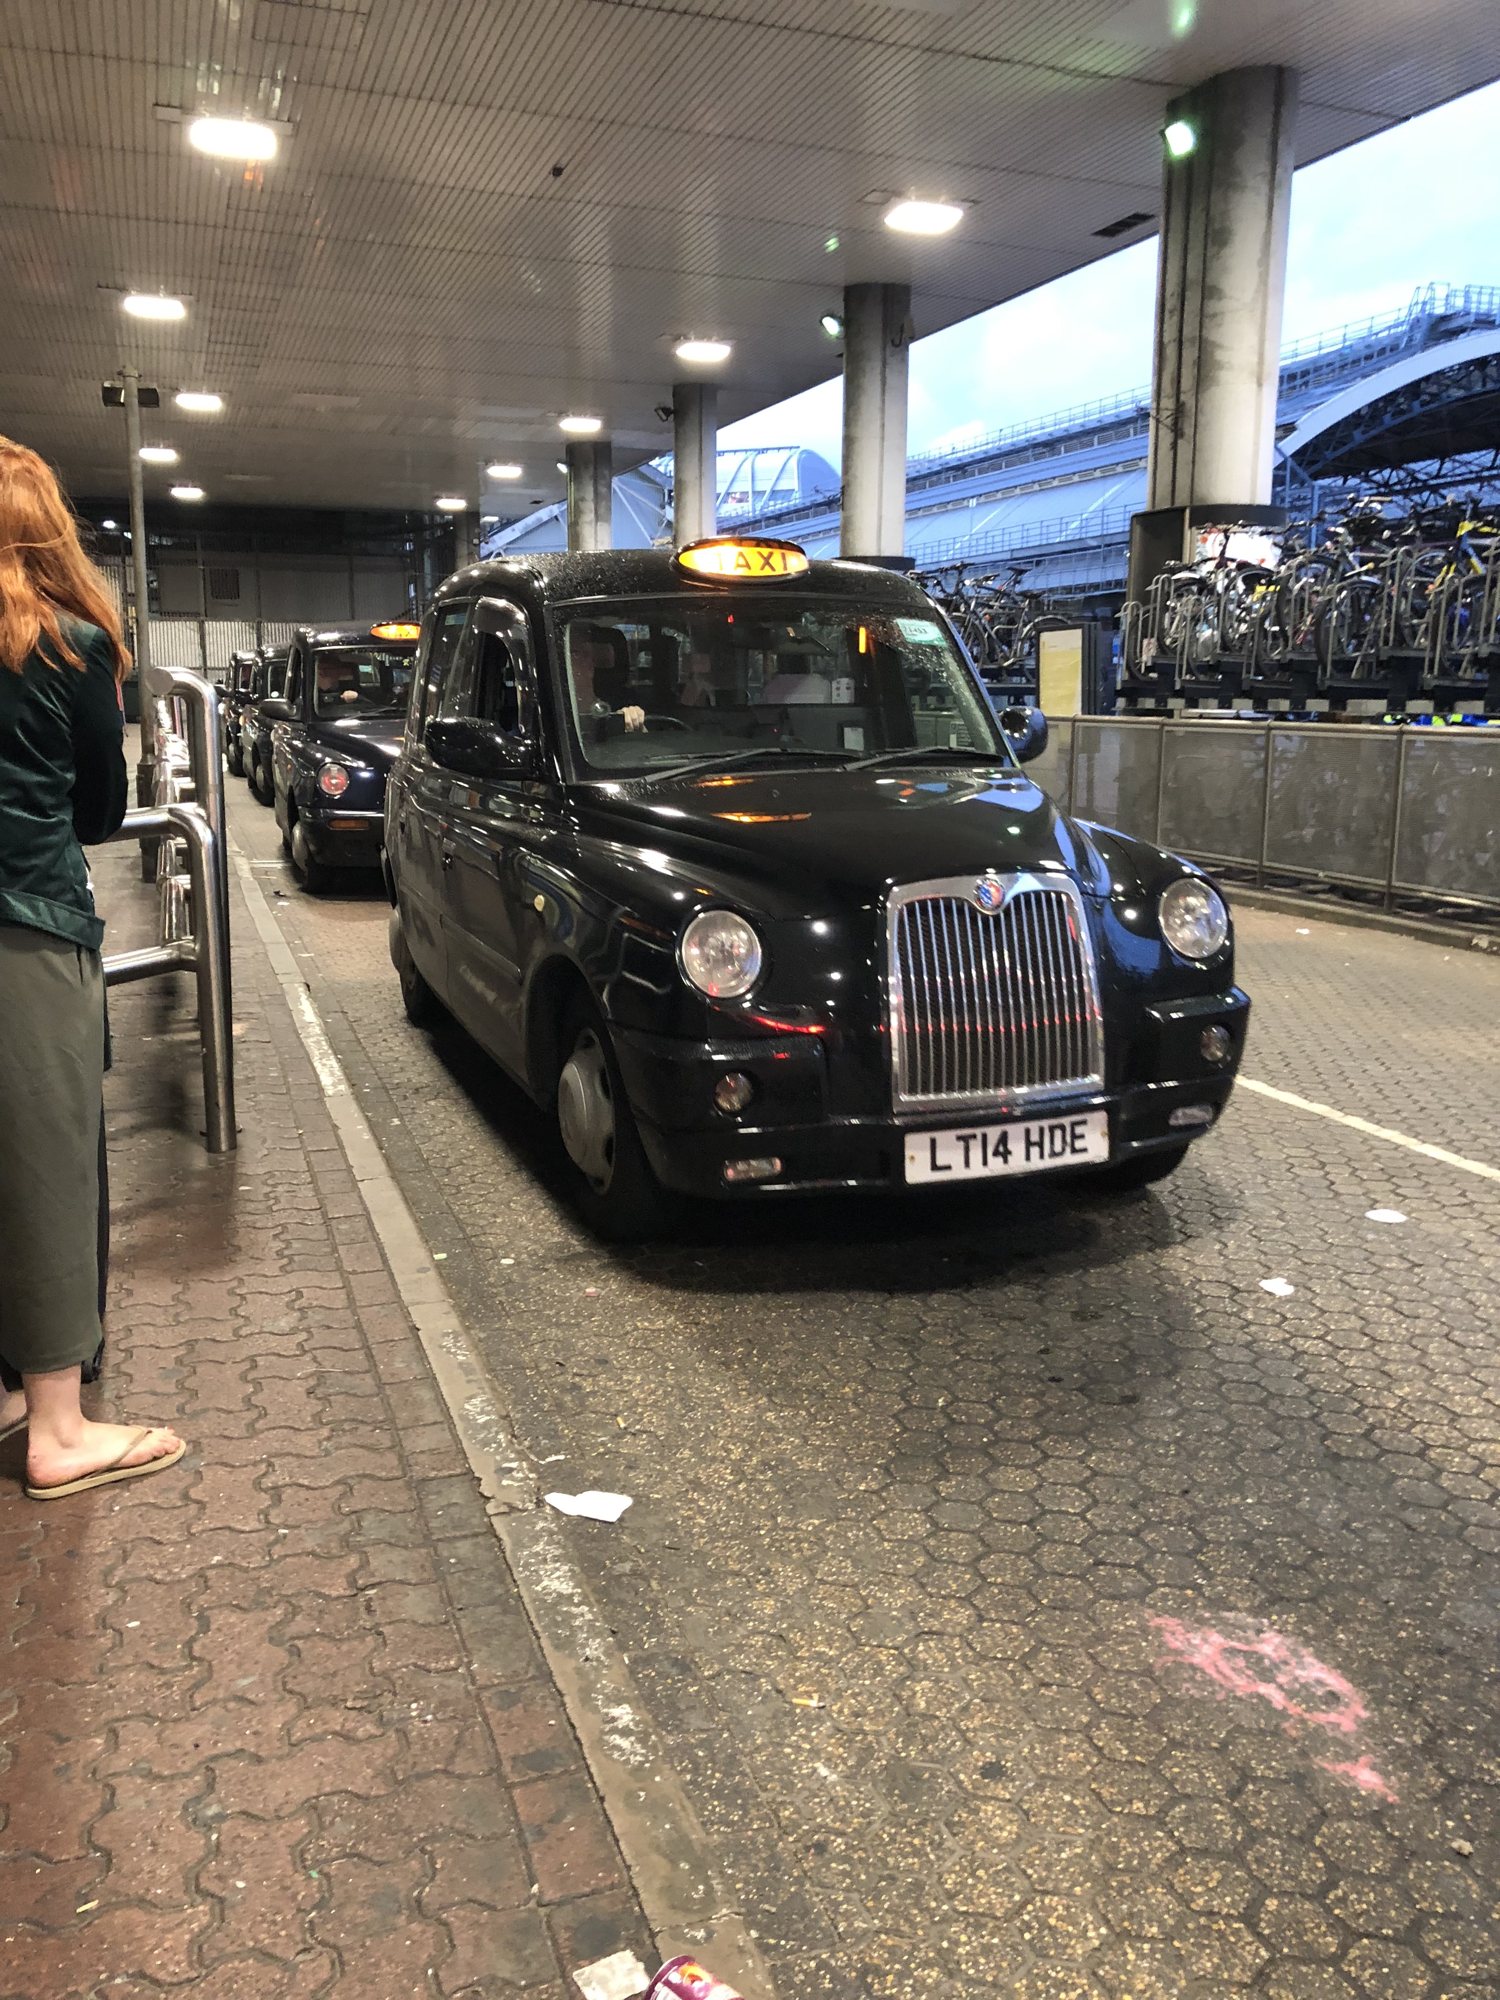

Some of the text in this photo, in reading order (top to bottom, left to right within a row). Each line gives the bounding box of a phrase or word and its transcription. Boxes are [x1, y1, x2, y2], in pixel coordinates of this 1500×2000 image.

[711, 550, 788, 572] TAXI
[929, 1118, 1088, 1172] LT14 HDE
